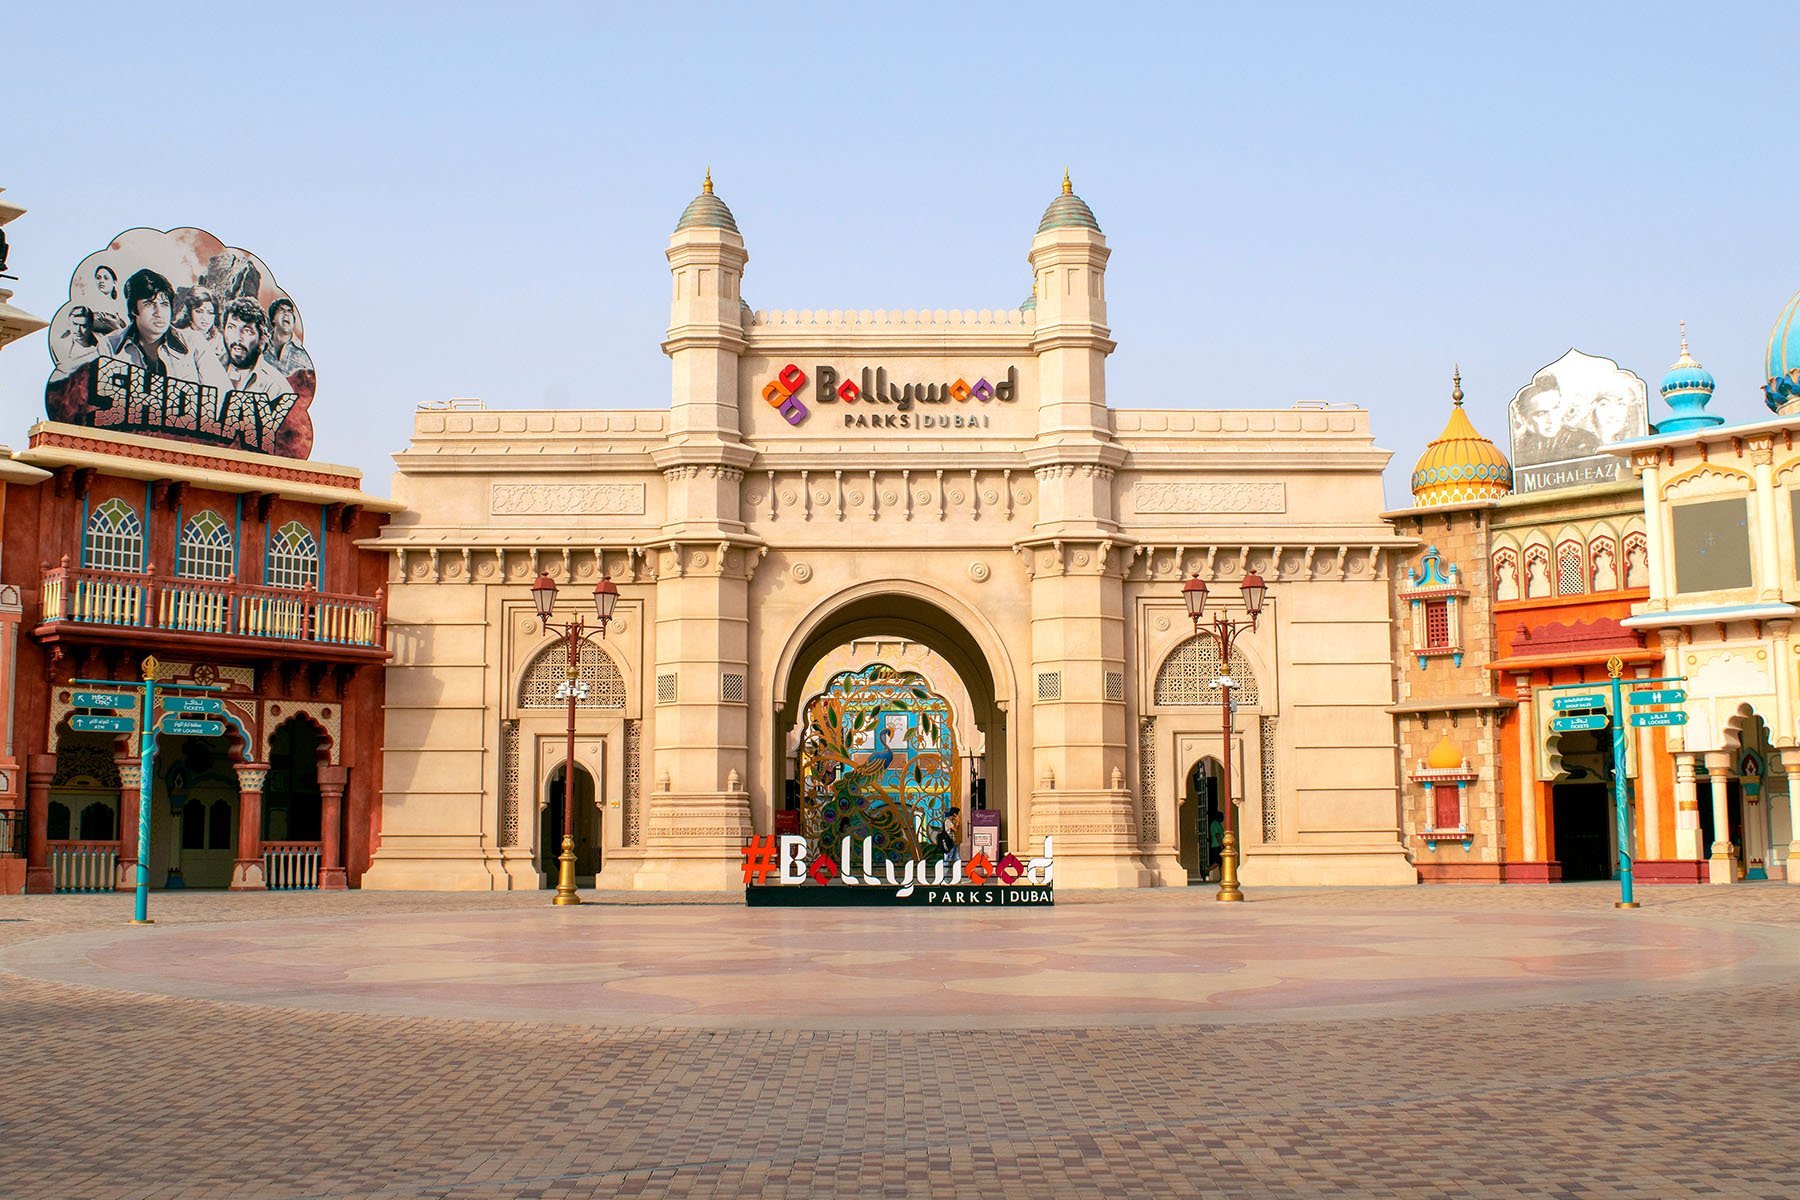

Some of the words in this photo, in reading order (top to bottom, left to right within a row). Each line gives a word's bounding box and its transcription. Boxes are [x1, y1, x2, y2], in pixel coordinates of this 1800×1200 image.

[91, 356, 299, 454] SHOLAY
[816, 365, 1015, 410] Bollywood
[844, 413, 910, 428] PARKS
[922, 413, 990, 428] DUBAI
[741, 834, 1053, 898] #Bollywood
[928, 891, 994, 903] PARKS
[1010, 890, 1053, 902] DUBAI
